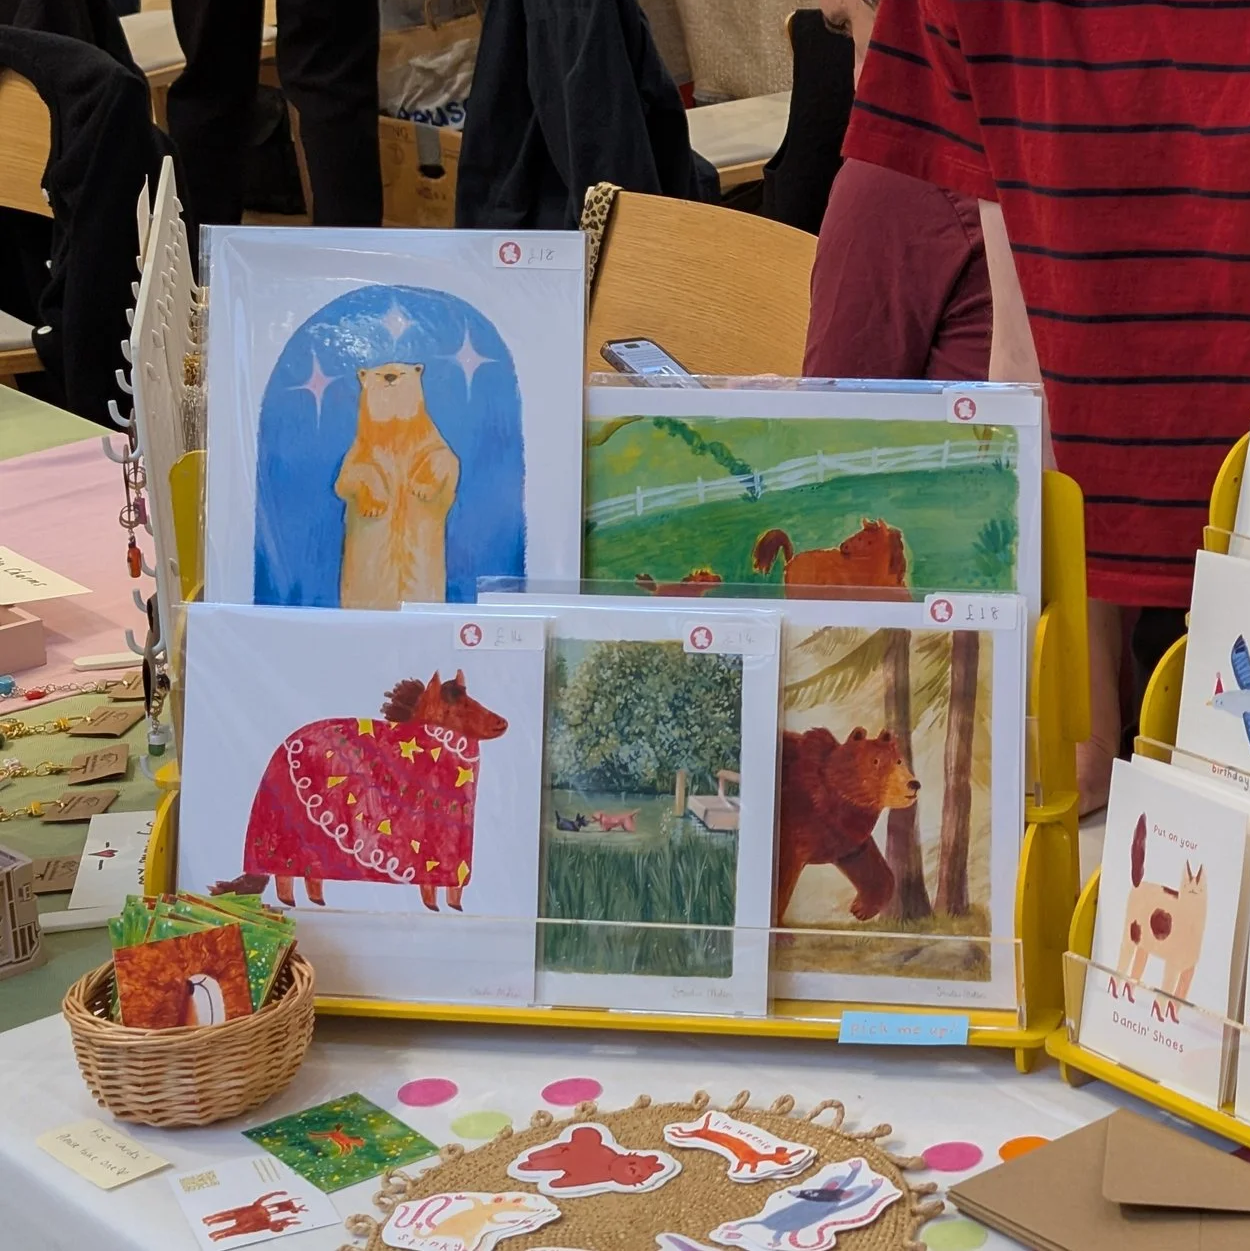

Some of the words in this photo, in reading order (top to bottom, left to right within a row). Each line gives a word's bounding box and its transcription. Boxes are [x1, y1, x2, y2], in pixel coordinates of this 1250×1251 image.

[1211, 764, 1250, 792] birthday
[1153, 824, 1167, 838] Put
[1168, 832, 1178, 843] on
[1180, 836, 1198, 851] your
[897, 1025, 921, 1036] me
[1112, 1010, 1151, 1038] Dancin'
[1153, 1029, 1185, 1054] Shoes
